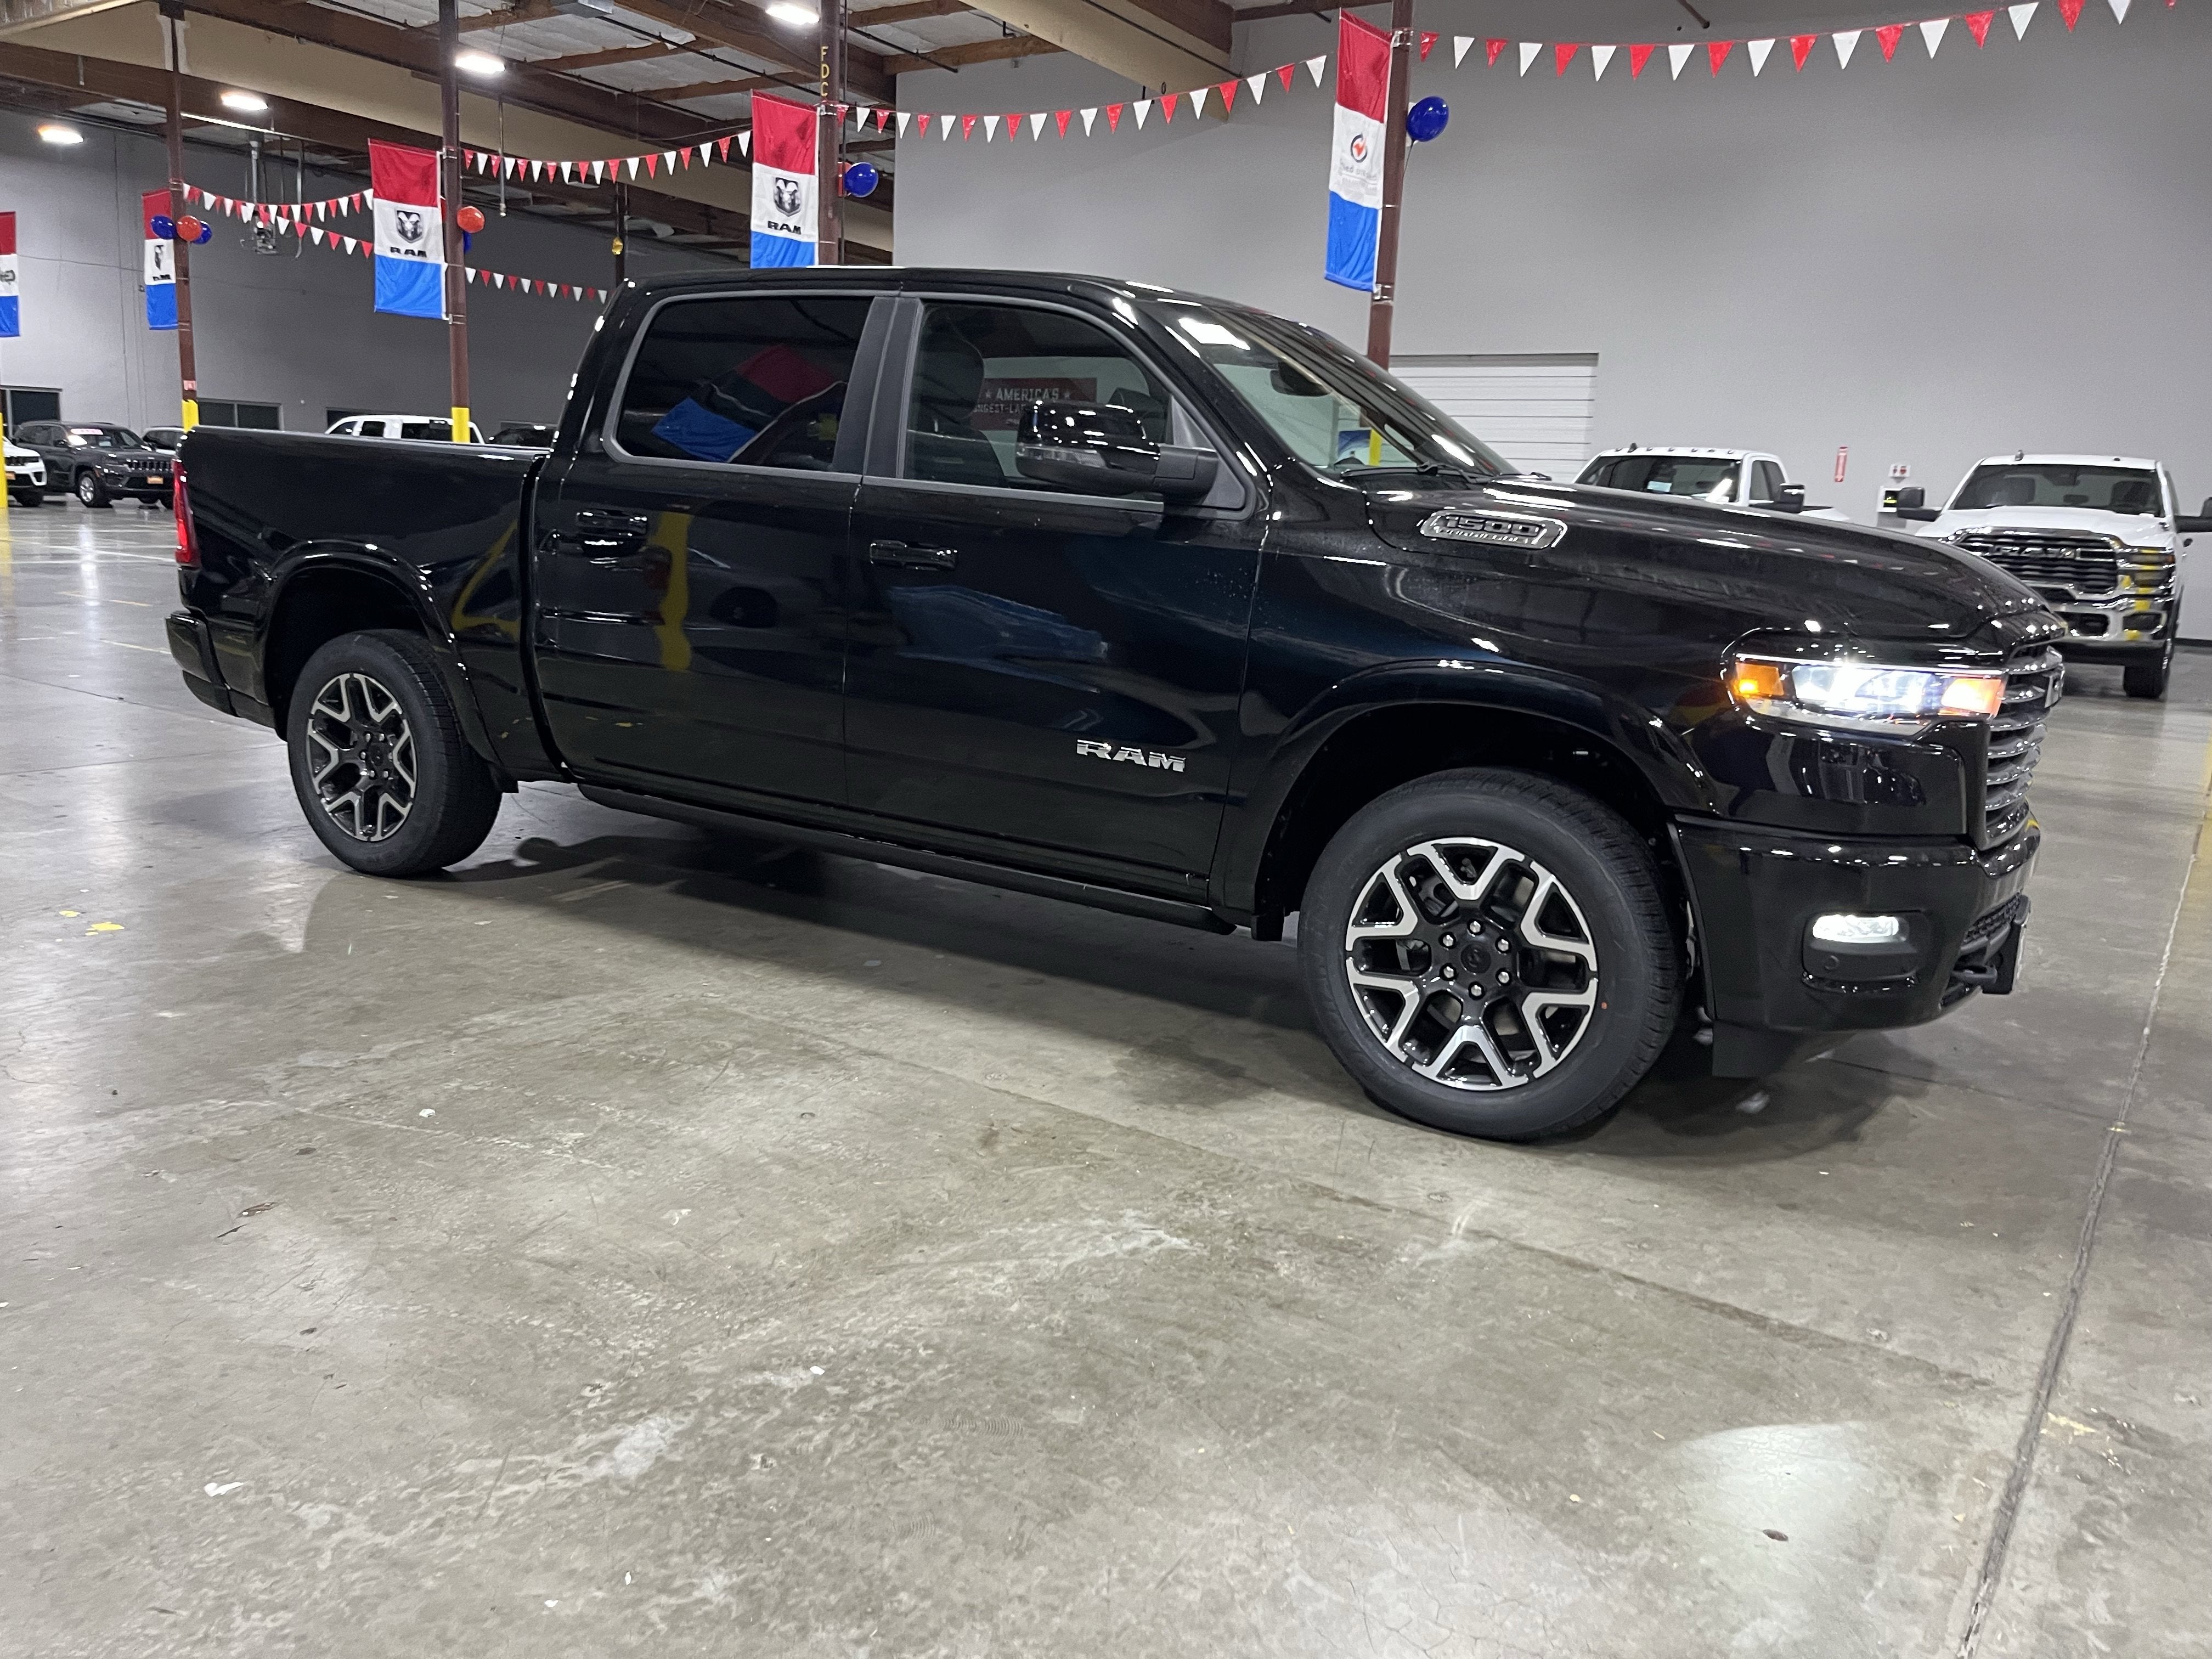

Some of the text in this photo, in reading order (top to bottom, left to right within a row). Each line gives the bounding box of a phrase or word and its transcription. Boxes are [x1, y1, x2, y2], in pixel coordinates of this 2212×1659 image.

[768, 220, 802, 235] RAM
[390, 246, 427, 258] RAM
[1445, 516, 1542, 537] 1500
[1076, 739, 1186, 772] RAM
